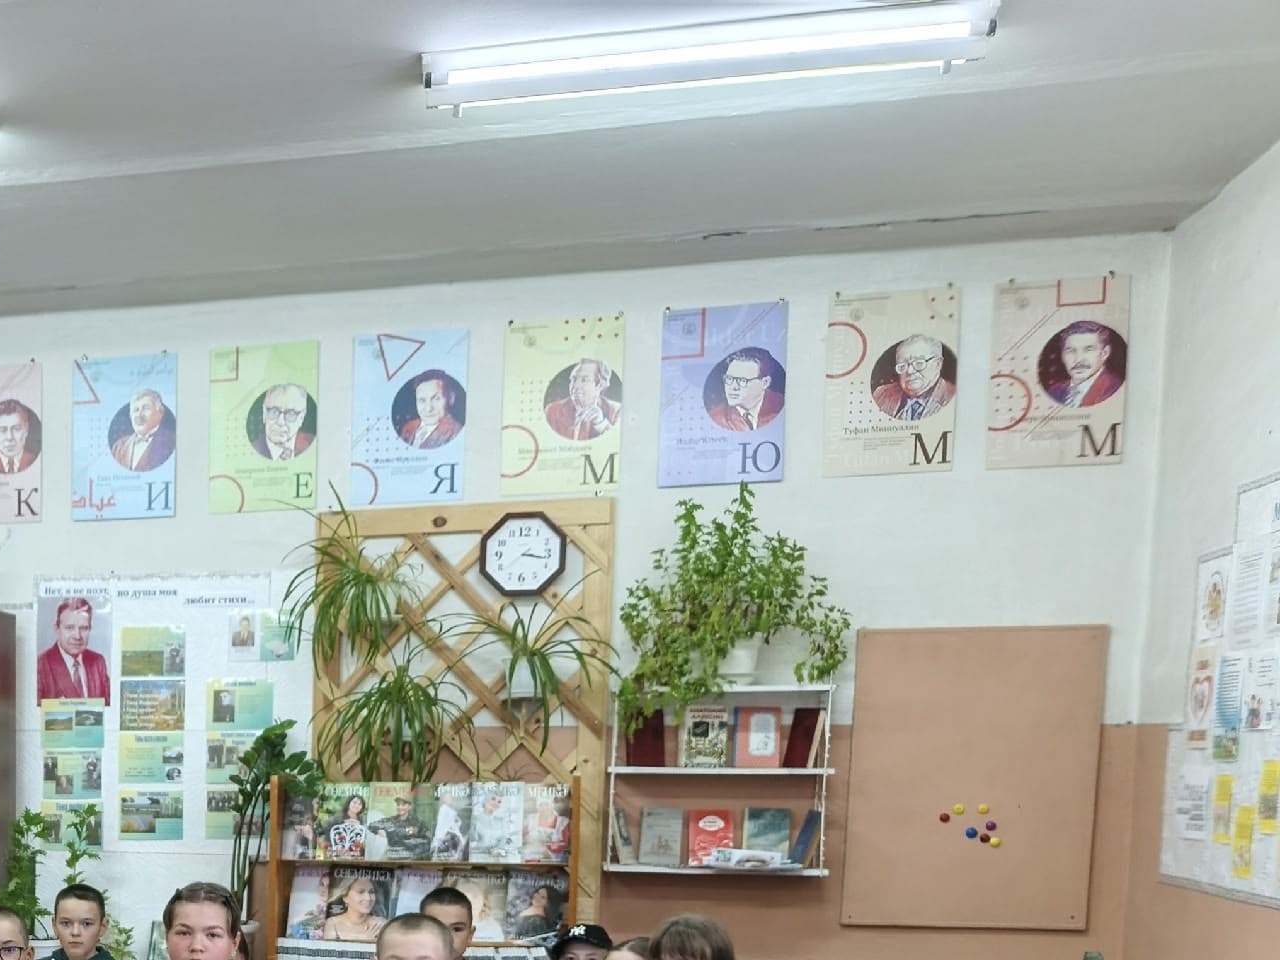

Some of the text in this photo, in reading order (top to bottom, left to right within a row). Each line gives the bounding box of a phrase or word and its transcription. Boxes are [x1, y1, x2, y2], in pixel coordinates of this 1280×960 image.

[909, 431, 952, 466] М
[1076, 422, 1122, 458] М
[579, 452, 618, 485] М
[737, 441, 781, 474] Ю
[293, 472, 313, 498] Е
[430, 462, 459, 494] Я
[15, 488, 38, 517] К
[145, 480, 173, 511] И
[131, 589, 157, 599] душа
